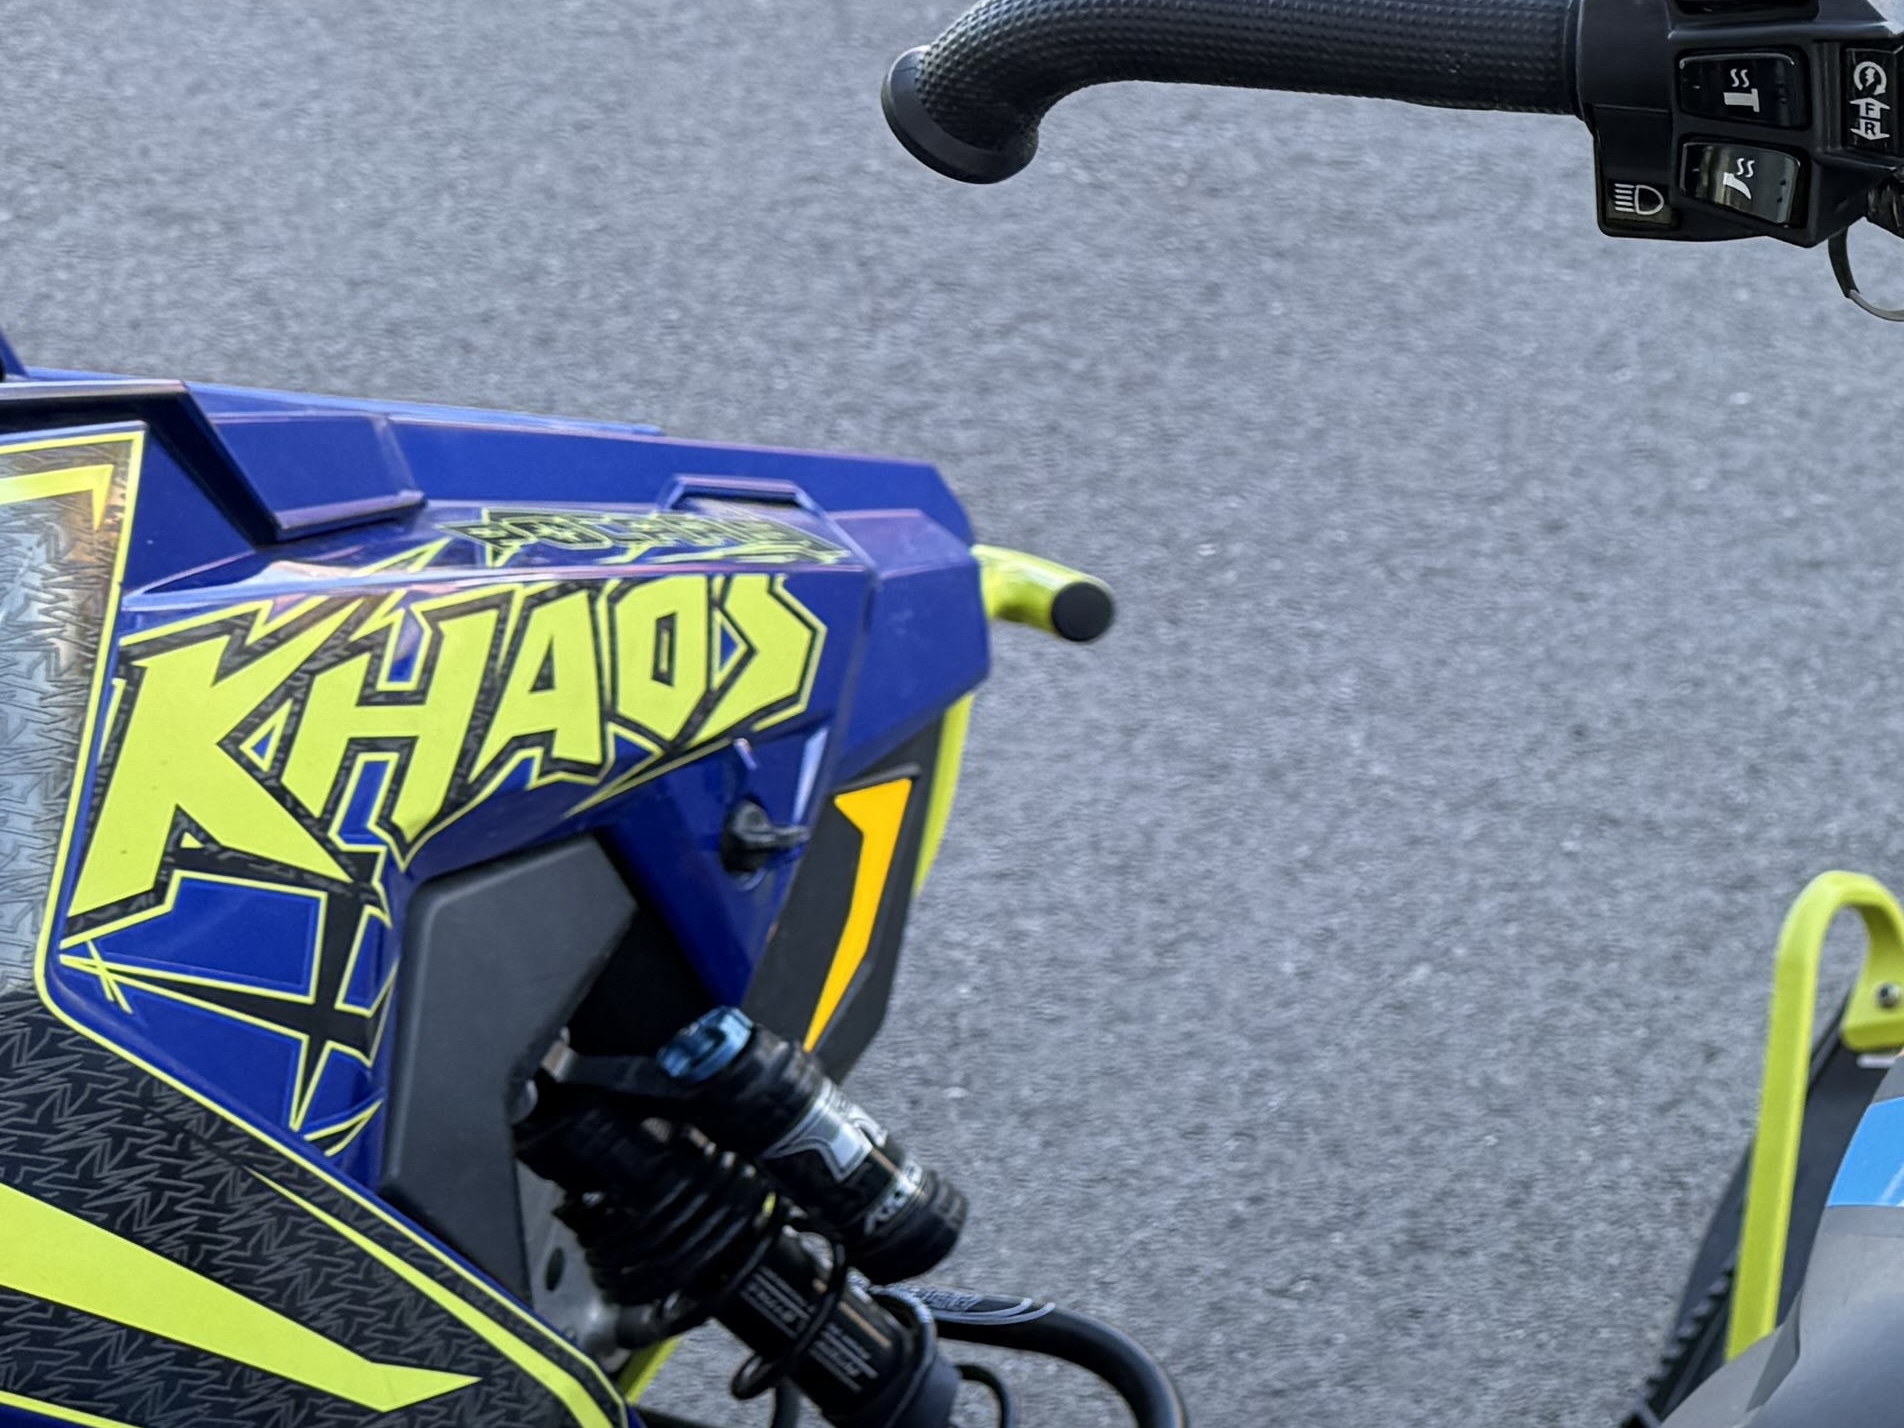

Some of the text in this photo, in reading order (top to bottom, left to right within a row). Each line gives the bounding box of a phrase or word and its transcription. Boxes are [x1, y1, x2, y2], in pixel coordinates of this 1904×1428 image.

[1865, 102, 1876, 118] F
[1865, 122, 1876, 136] R
[67, 572, 823, 921] KHAOS
